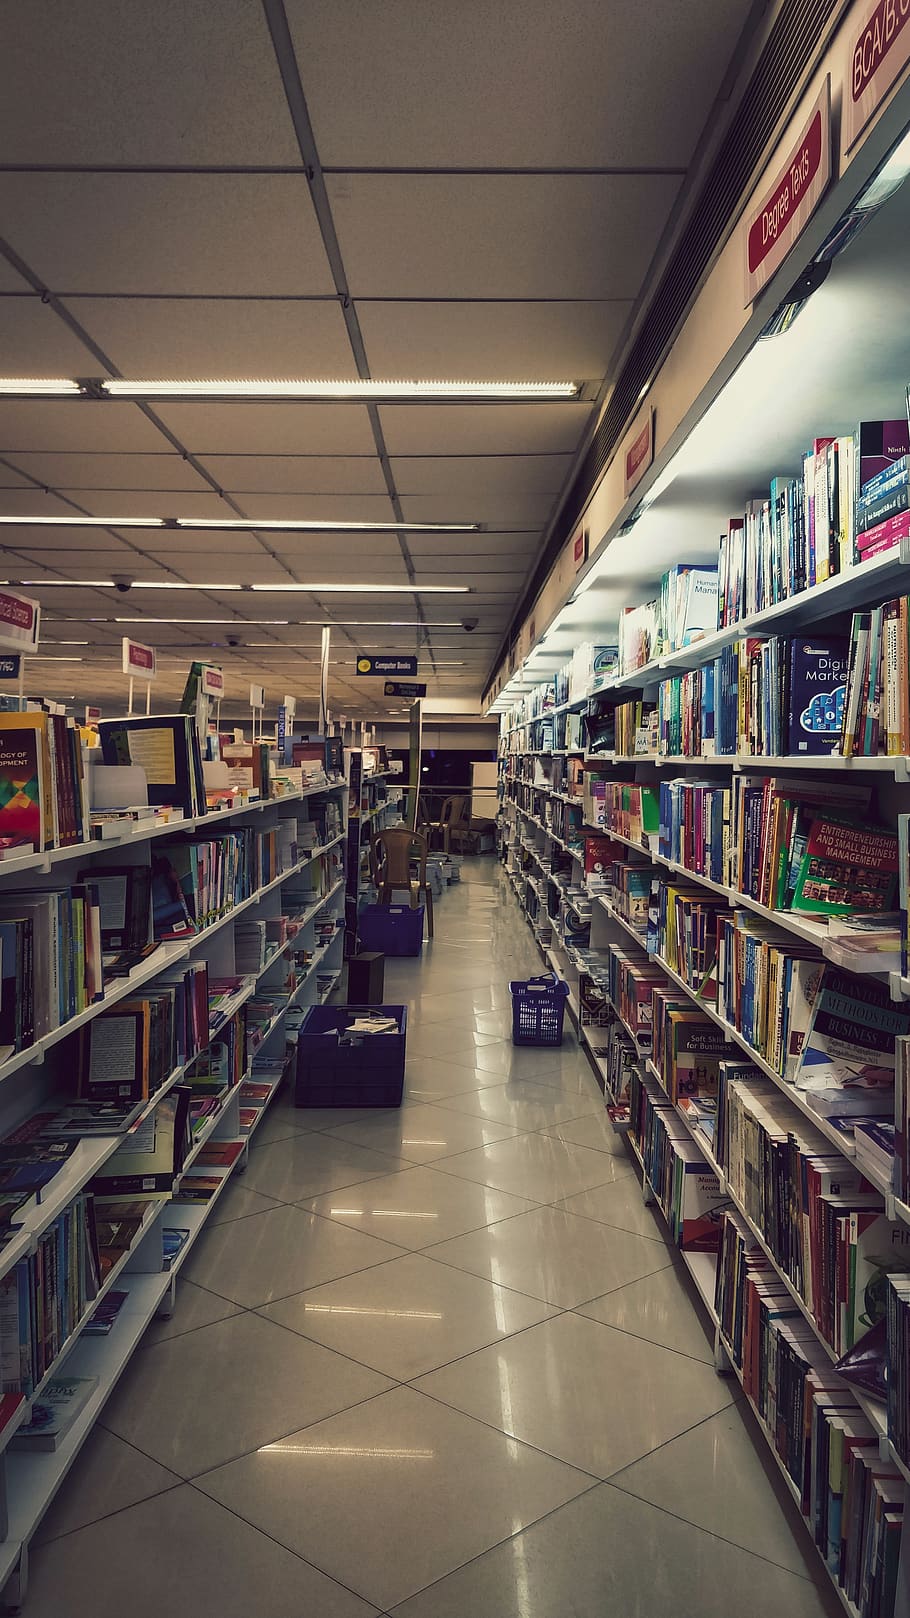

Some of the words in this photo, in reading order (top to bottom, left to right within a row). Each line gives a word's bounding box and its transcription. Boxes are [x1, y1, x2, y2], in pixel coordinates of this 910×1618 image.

[761, 188, 789, 246] Degree
[789, 149, 810, 200] Texts
[375, 661, 397, 671] Computer
[816, 834, 834, 846] AND
[834, 838, 860, 853] SMALL
[860, 845, 897, 860] BUSINESS
[820, 824, 897, 848] ENTREPRENEURSHIP
[825, 847, 882, 867] MANAGEMENT
[690, 1035, 706, 1043] Soft
[828, 1018, 878, 1044] BUSINESS
[686, 1041, 697, 1049] for
[700, 1043, 732, 1051] Business
